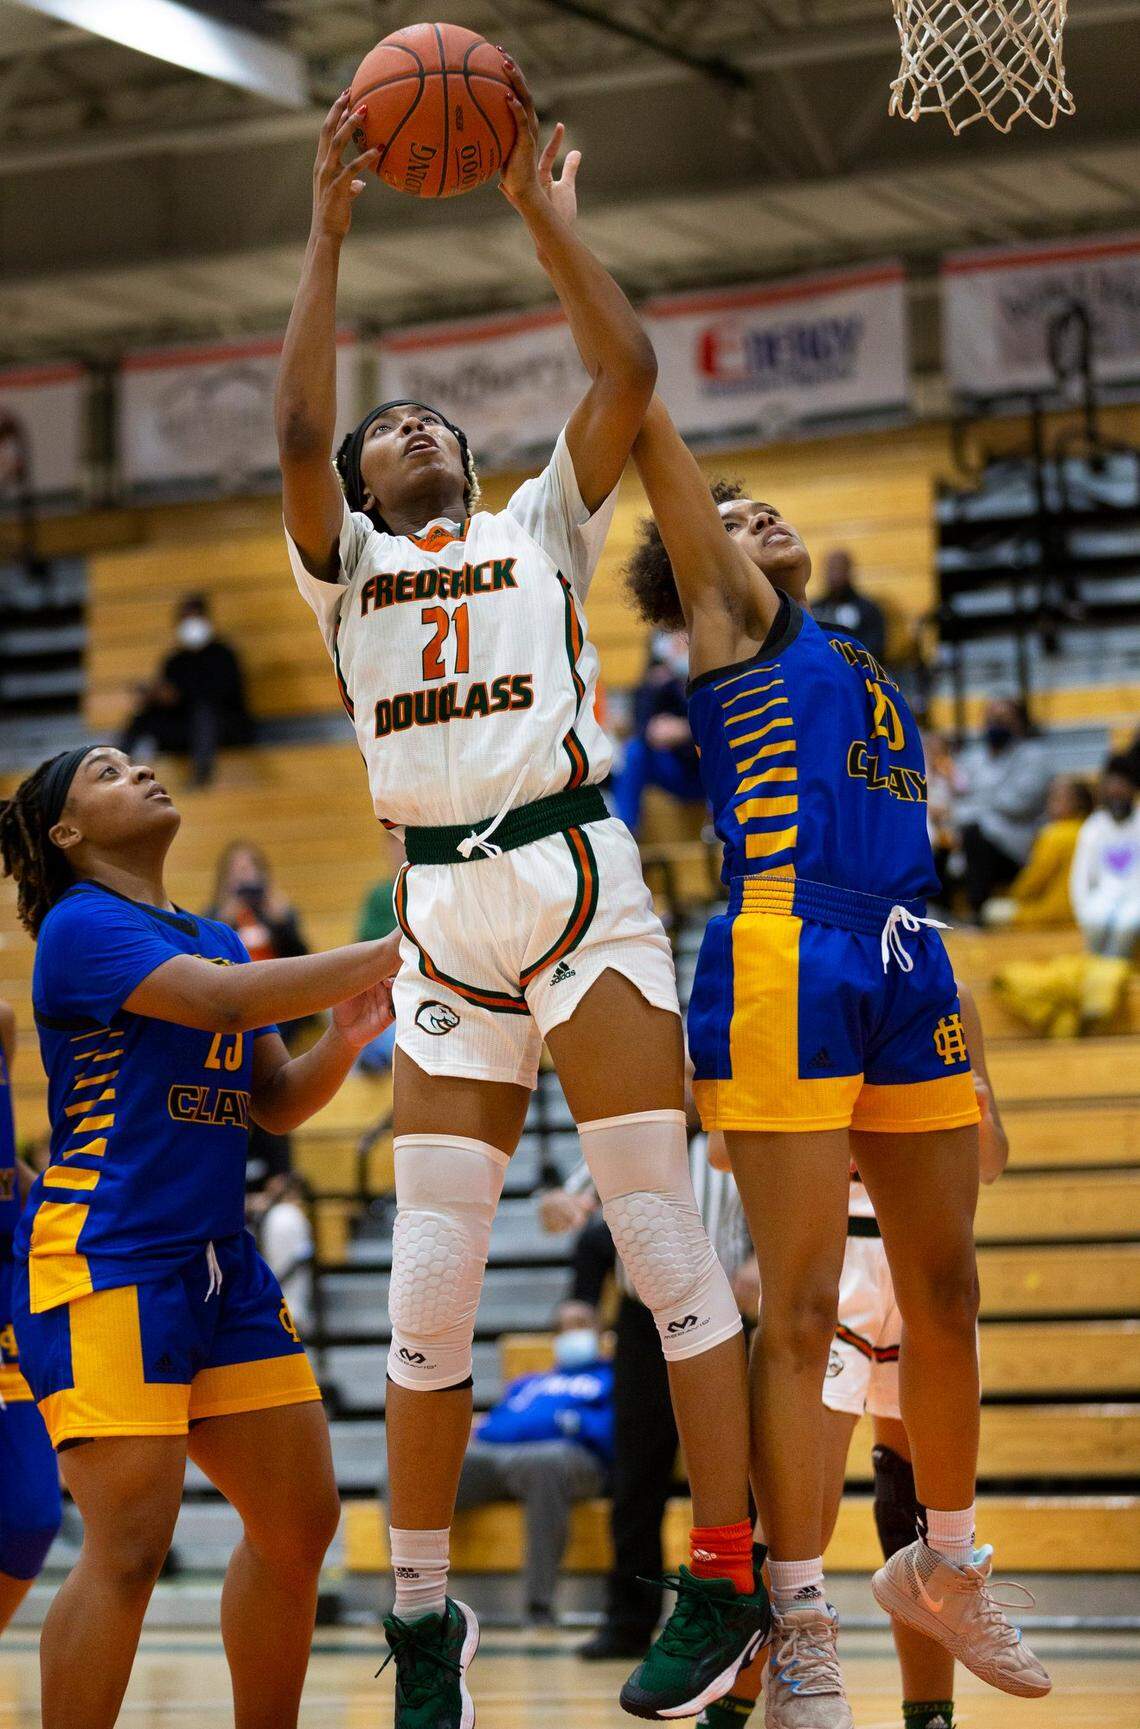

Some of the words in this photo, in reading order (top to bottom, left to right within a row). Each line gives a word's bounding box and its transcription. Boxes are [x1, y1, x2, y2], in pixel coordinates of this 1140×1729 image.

[360, 557, 519, 618] FREDERICK
[421, 602, 470, 681] 21
[375, 673, 535, 739] DOUGLASS
